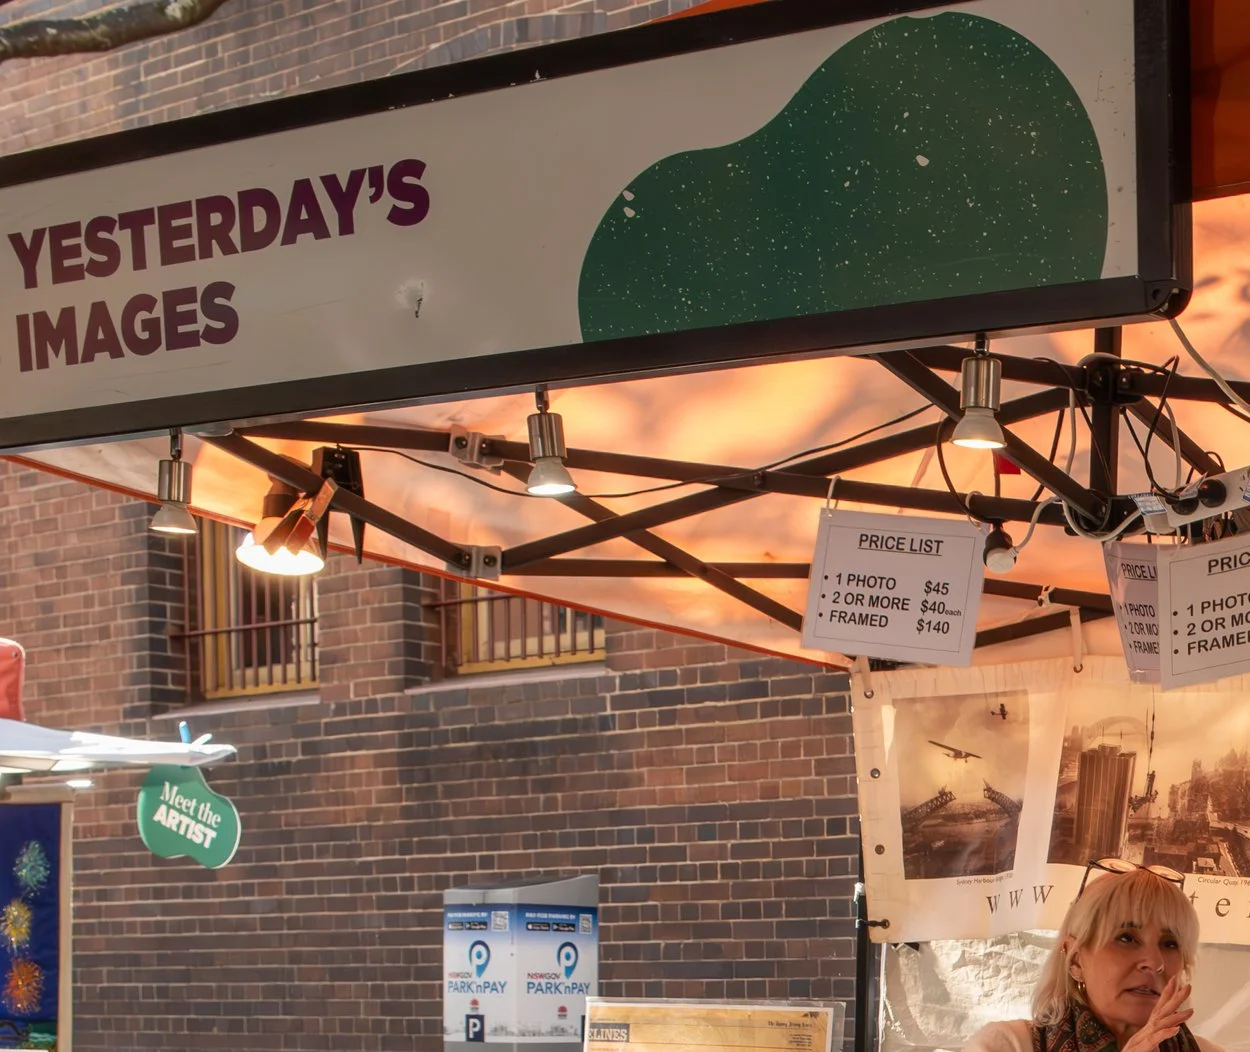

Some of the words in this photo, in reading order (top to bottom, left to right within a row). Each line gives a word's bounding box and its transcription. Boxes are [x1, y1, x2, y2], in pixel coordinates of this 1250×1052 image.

[8, 159, 430, 289] YESTERDAY'S
[15, 281, 239, 372] IMAGES
[858, 533, 906, 551] PRICE
[909, 539, 944, 554] LIST
[1121, 563, 1147, 578] PRICE
[836, 573, 842, 585] 1
[846, 574, 896, 590] PHOTO
[924, 580, 949, 596] $45
[832, 591, 840, 603] 2
[844, 593, 864, 606] OR
[868, 595, 911, 611] MORE
[1130, 604, 1156, 617] PHOTO
[1187, 604, 1194, 616] 1
[829, 610, 888, 628] FRAMED
[916, 618, 950, 635] $140
[1128, 622, 1134, 634] 2
[1134, 623, 1145, 635] OR
[1187, 623, 1196, 636] 2
[1201, 617, 1228, 633] OR
[1133, 641, 1160, 654] FRAME
[160, 781, 197, 816] Meet
[197, 802, 221, 828] the
[152, 804, 218, 849] ARTIST
